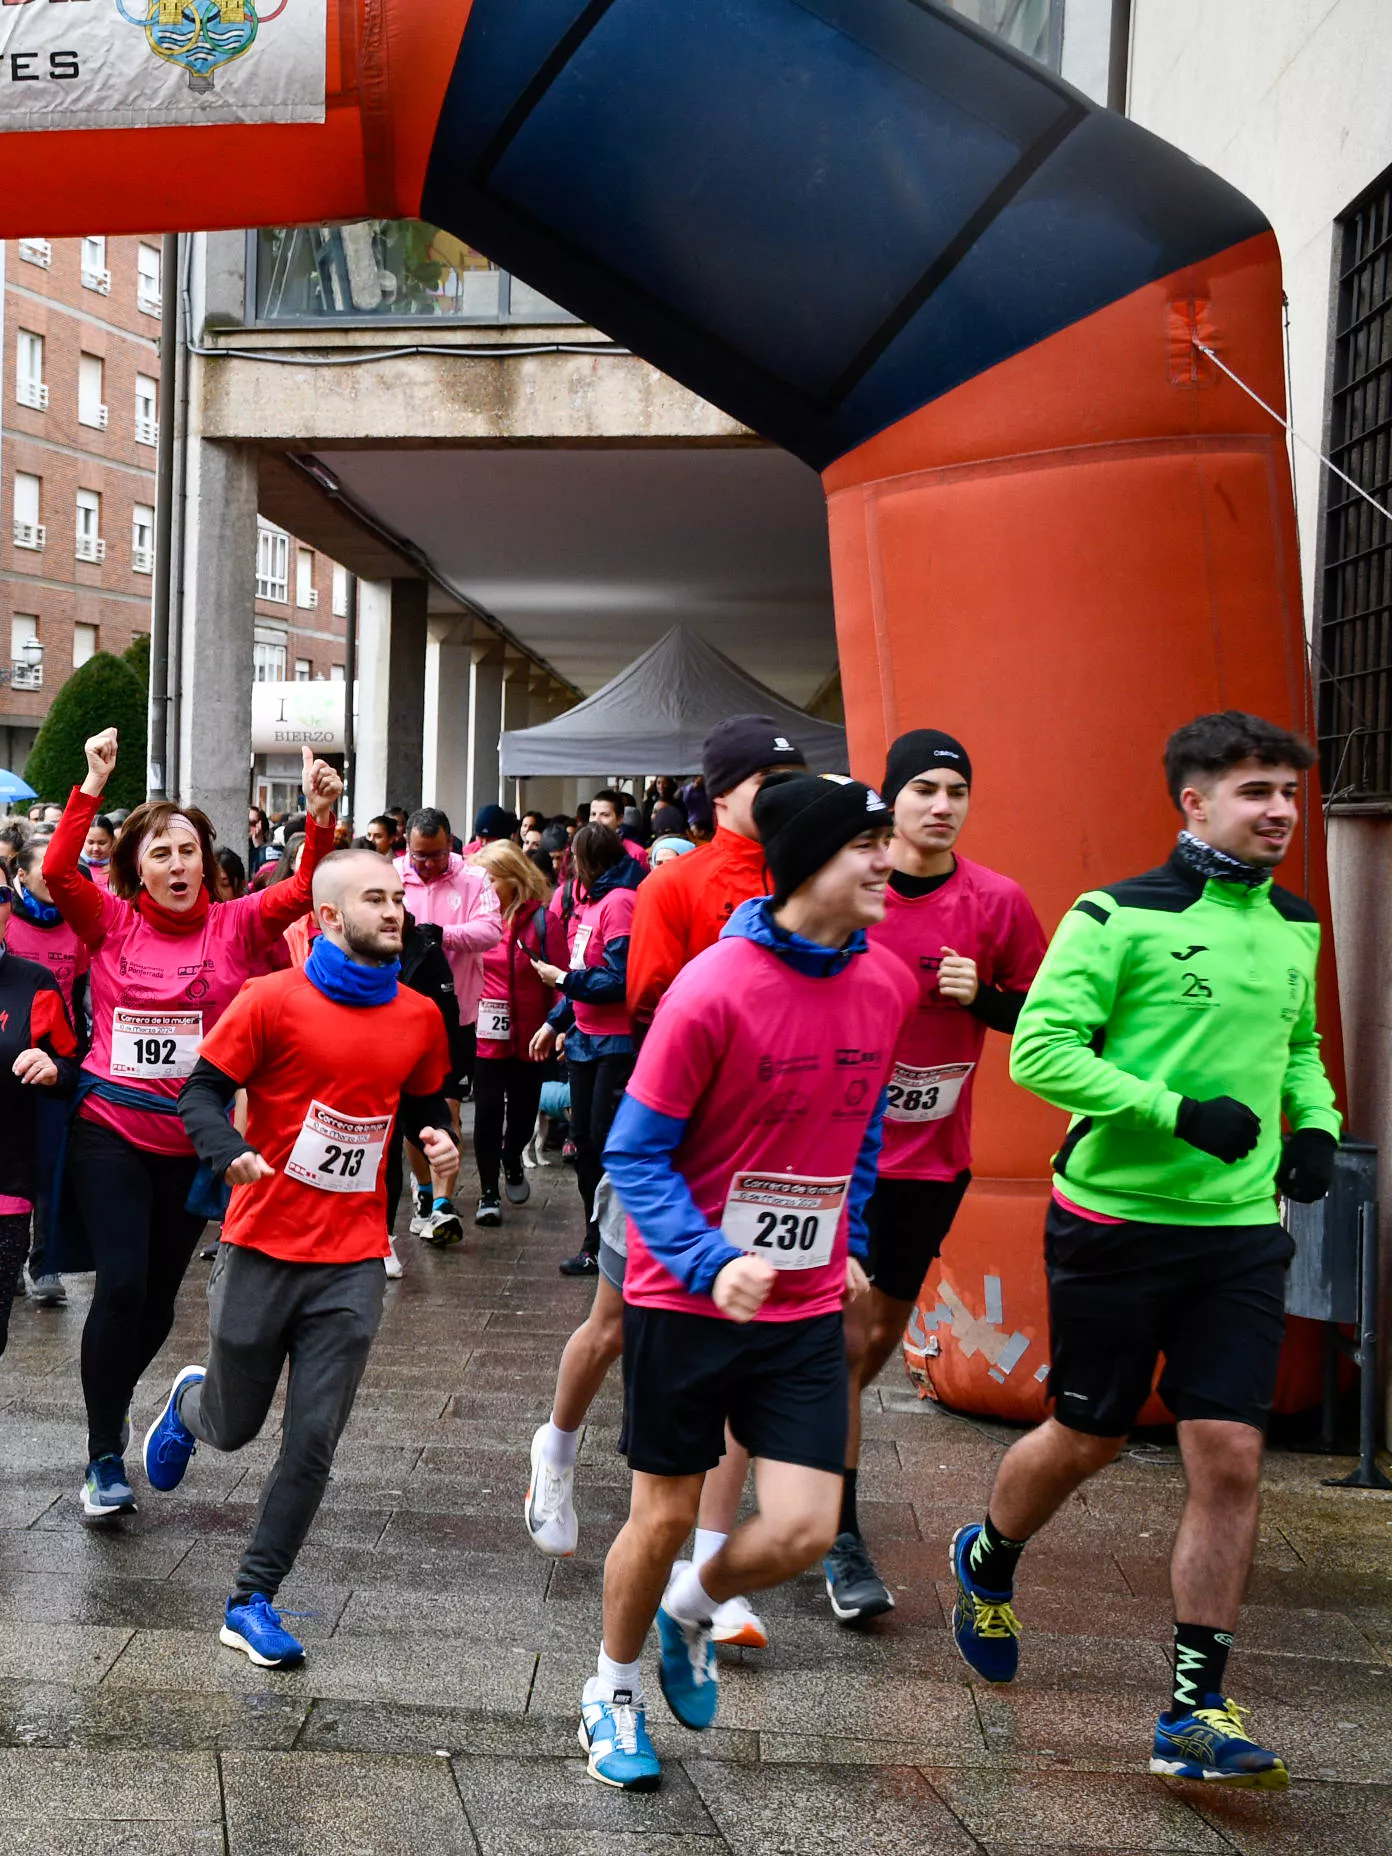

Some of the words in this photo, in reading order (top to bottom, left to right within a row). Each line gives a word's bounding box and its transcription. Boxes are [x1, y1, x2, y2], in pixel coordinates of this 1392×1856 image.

[274, 731, 334, 743] BIERZO
[128, 966, 164, 979] Ponferrada
[1181, 972, 1212, 998] 25
[121, 1014, 150, 1024] Carrera
[151, 1016, 161, 1024] de
[162, 1016, 170, 1024] la
[171, 1016, 195, 1025] mujer
[133, 1039, 176, 1064] 192
[887, 1085, 939, 1111] 283
[317, 1110, 353, 1131] Carrera
[318, 1144, 365, 1177] 213
[753, 1211, 819, 1250] 230
